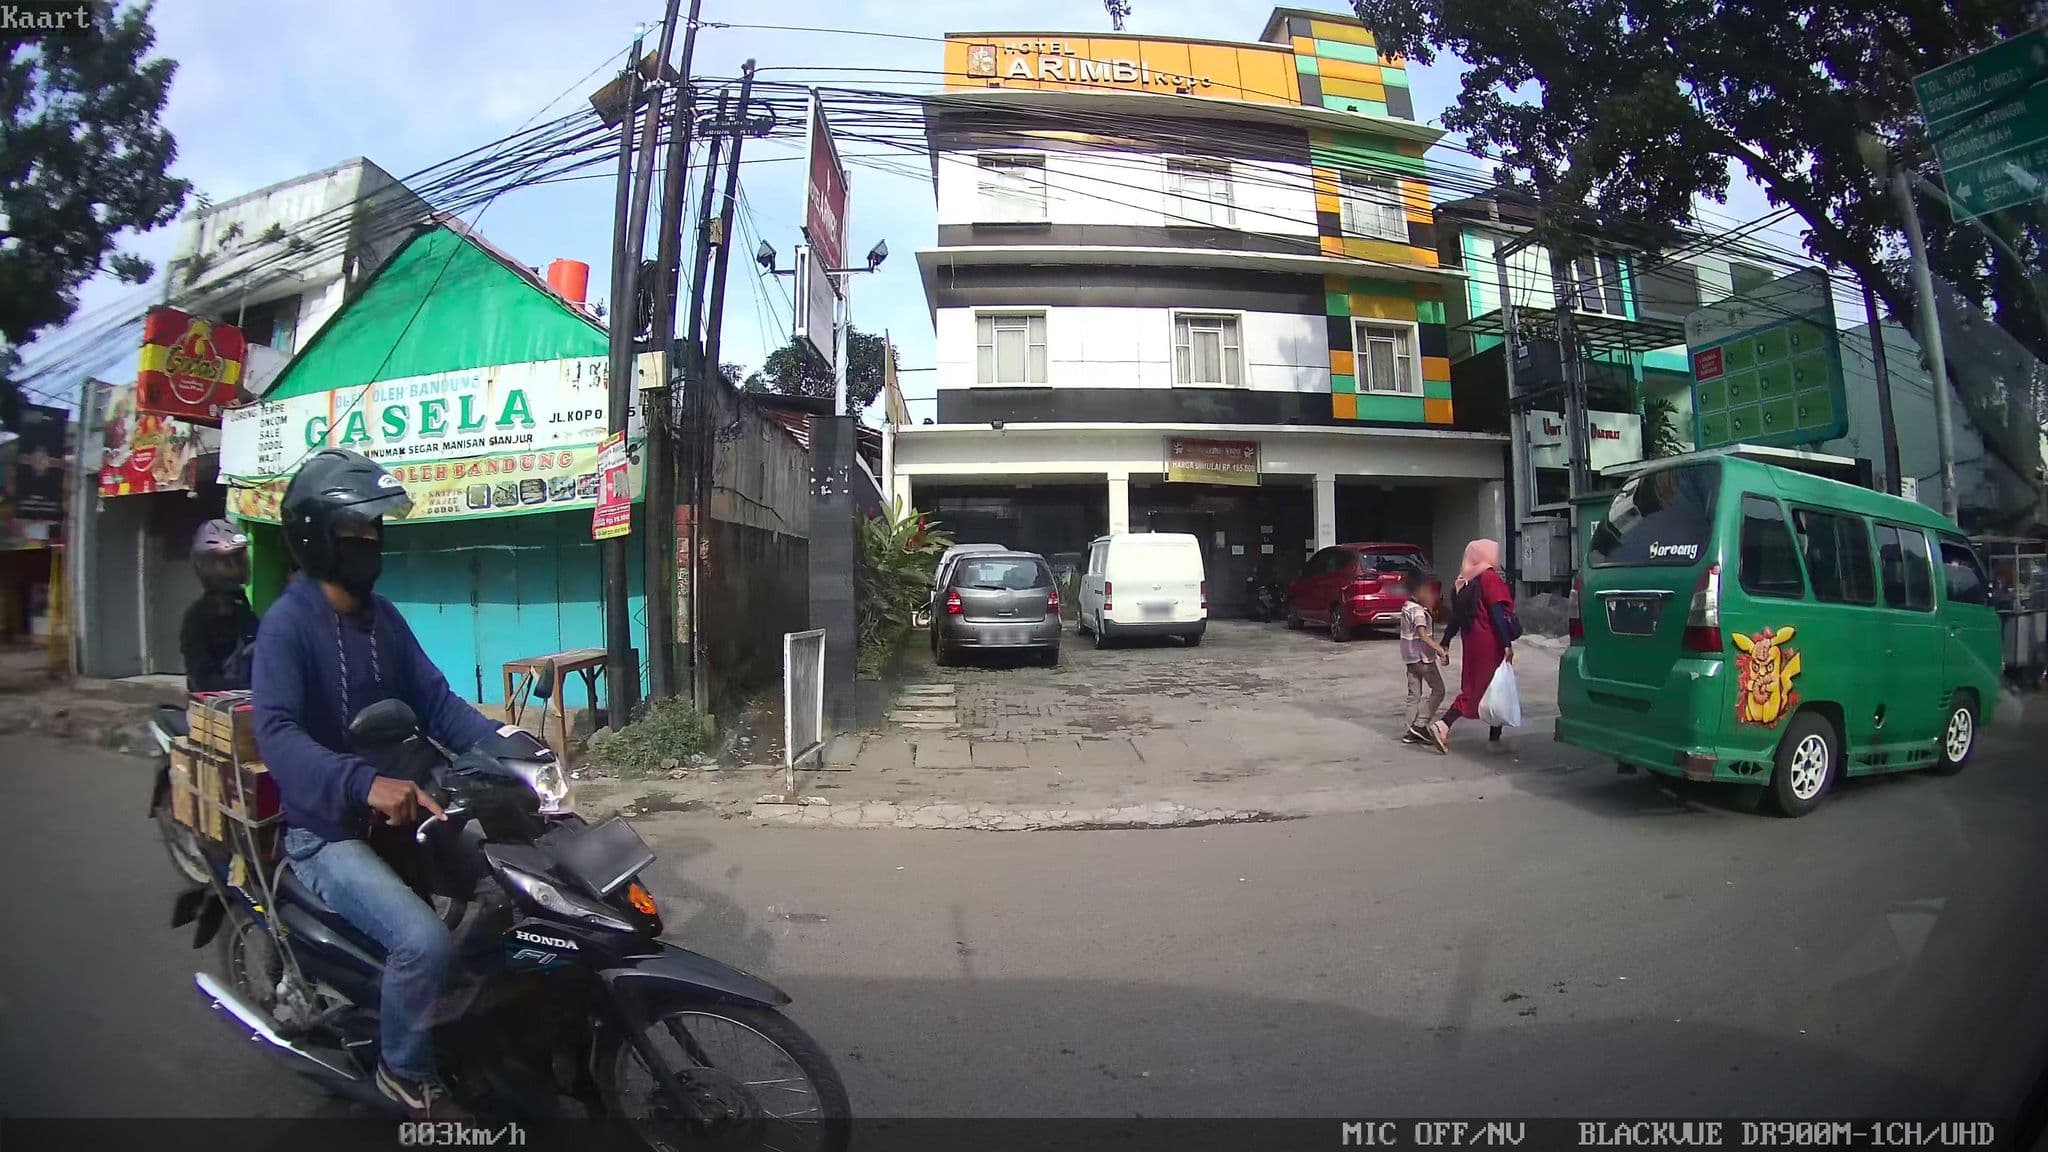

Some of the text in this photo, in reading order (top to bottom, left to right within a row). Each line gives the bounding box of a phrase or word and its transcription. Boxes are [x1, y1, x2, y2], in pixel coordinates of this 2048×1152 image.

[1004, 42, 1075, 56] HOTEL
[1004, 54, 1150, 84] ARIMBI
[373, 386, 404, 402] OLEH
[304, 388, 537, 450] GASELA
[259, 427, 280, 440] SALE
[408, 443, 439, 455] SEGAR
[442, 438, 486, 451] MANISAN
[393, 463, 448, 482] OLEH
[453, 451, 574, 478] BANDUNG
[515, 930, 580, 950] HONDA
